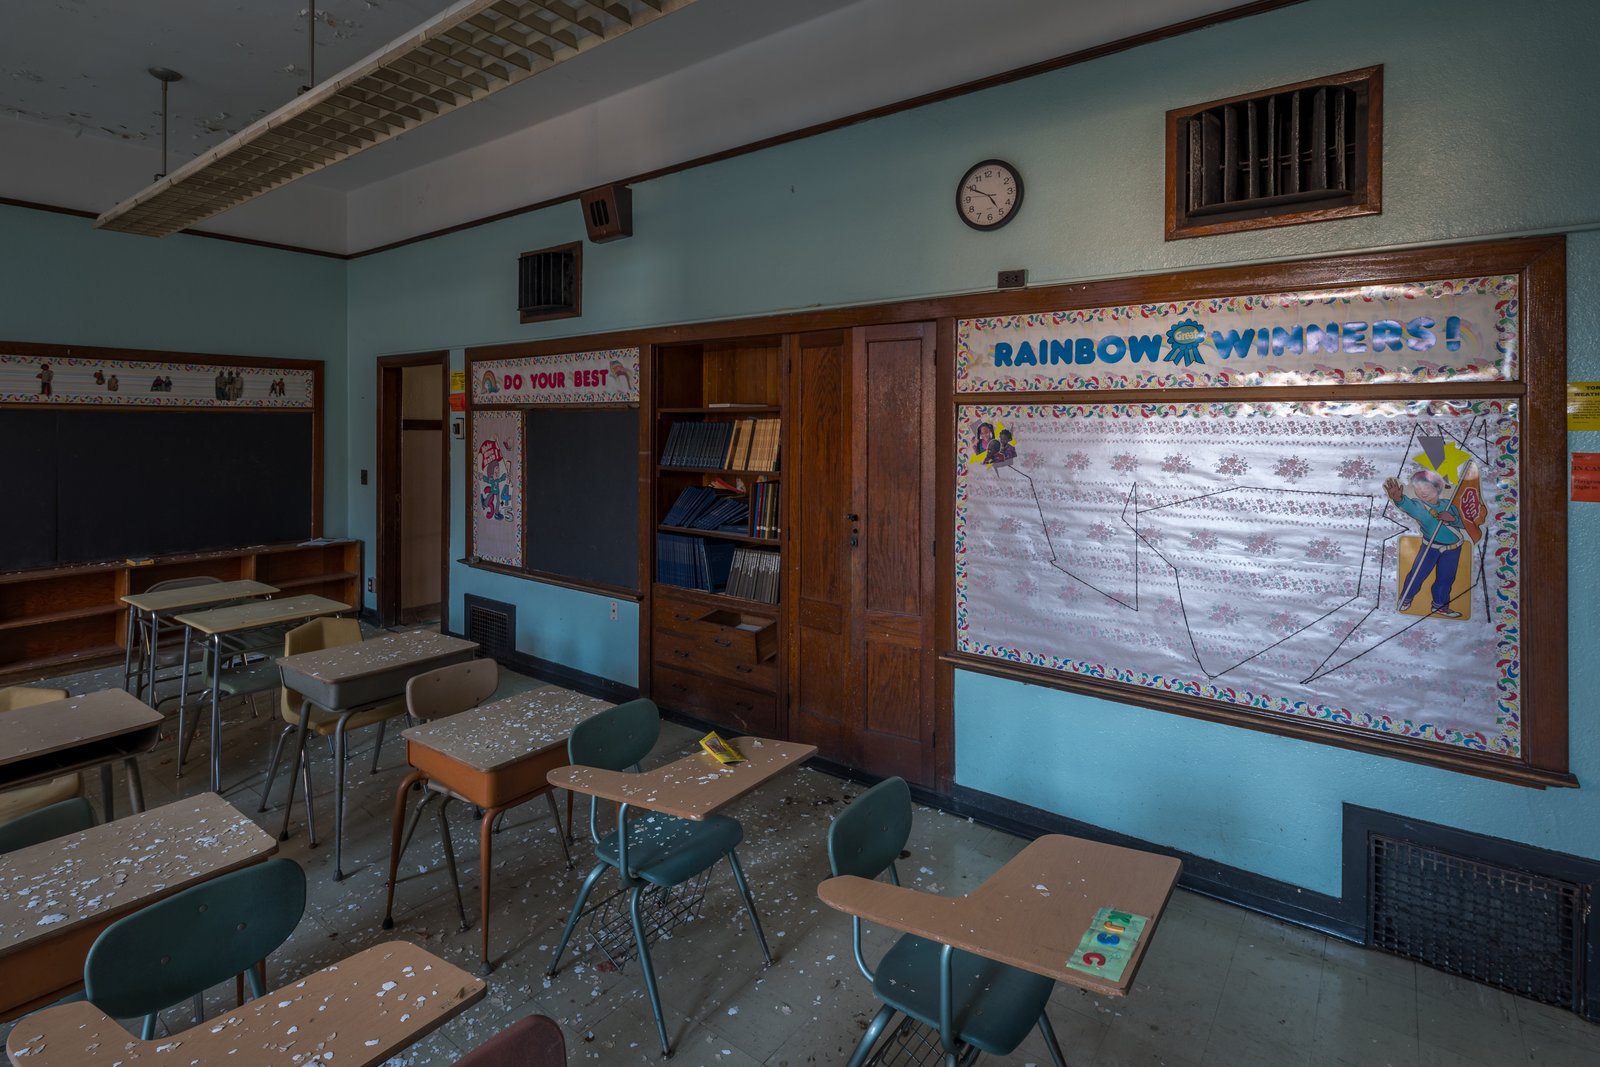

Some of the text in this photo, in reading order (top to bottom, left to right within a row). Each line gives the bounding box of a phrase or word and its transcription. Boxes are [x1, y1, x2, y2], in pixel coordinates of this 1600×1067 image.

[984, 170, 992, 178] 12
[1007, 187, 1013, 195] 3
[1174, 329, 1200, 341] Great
[994, 316, 1461, 367] RAINBOW WINNERS!
[504, 369, 609, 391] DO YOUR BEST
